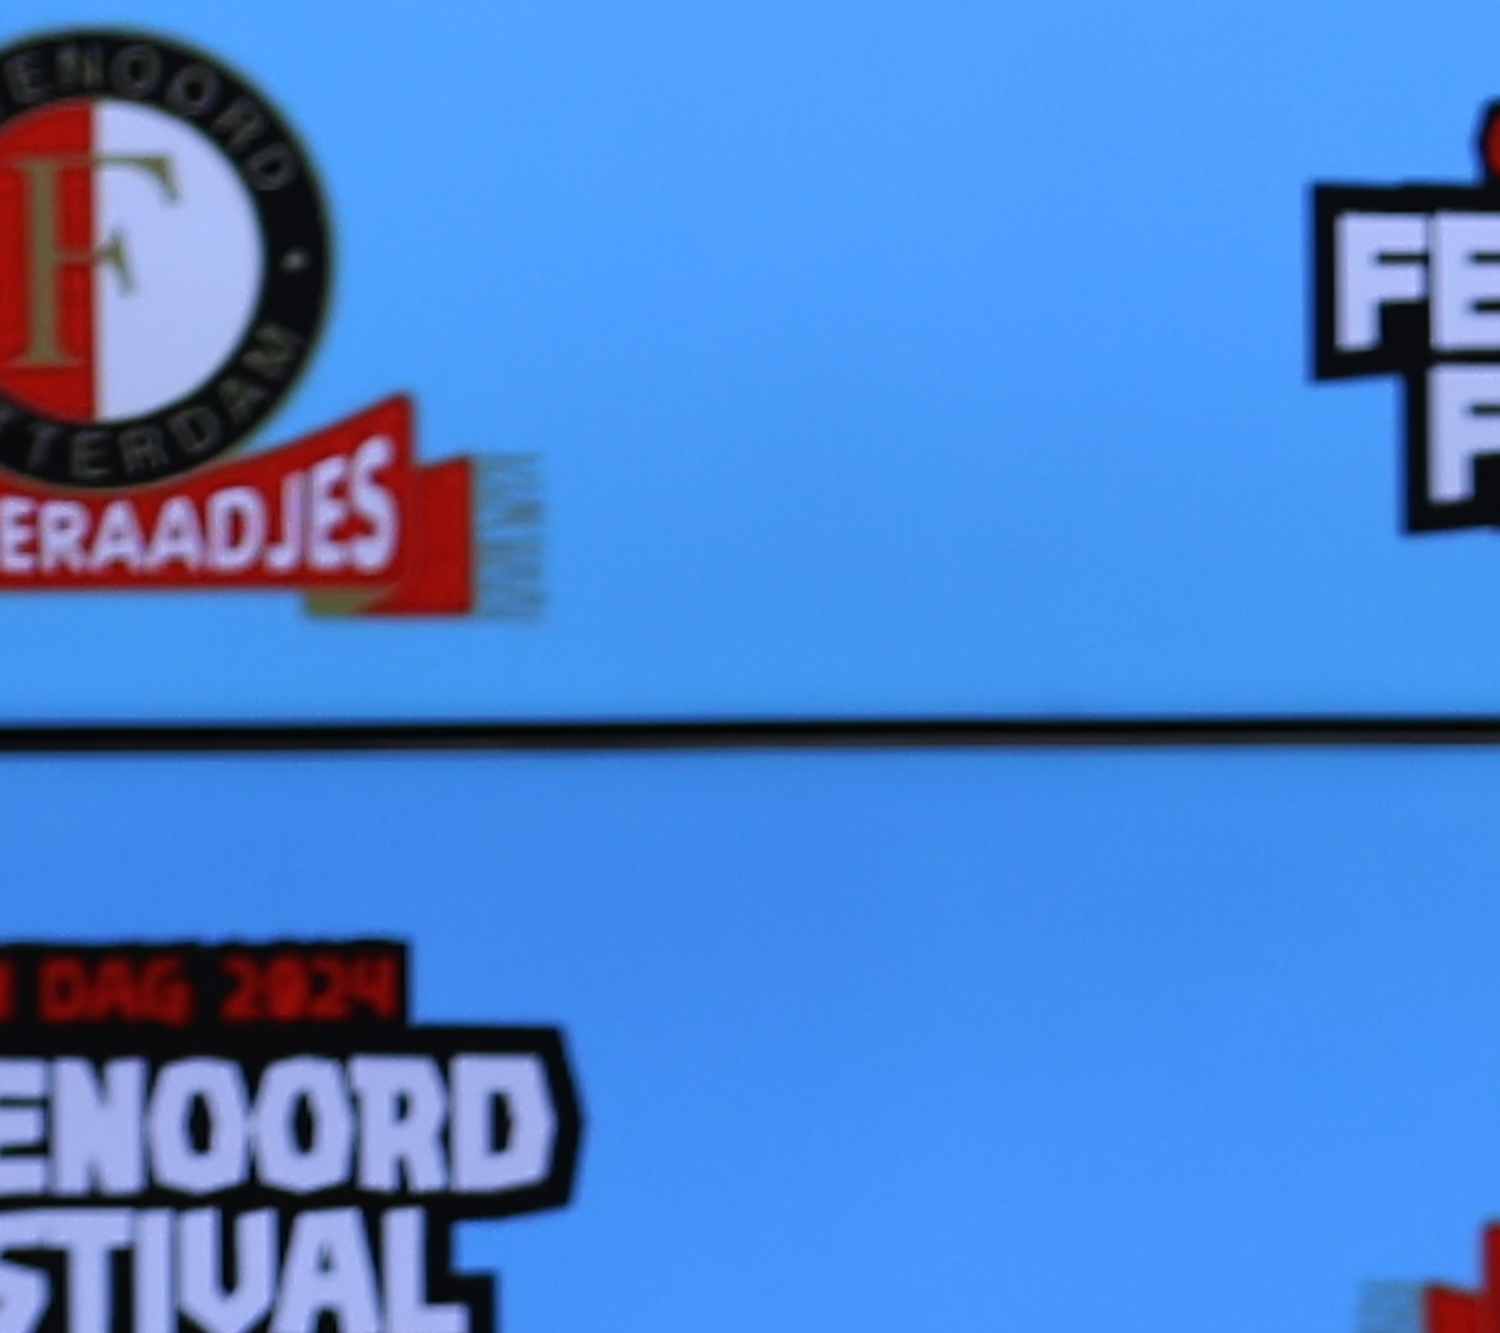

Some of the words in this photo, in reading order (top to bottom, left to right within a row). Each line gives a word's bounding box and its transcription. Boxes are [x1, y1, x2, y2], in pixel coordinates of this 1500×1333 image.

[0, 434, 398, 573] ERAADJES
[38, 955, 193, 1029] DAG
[219, 955, 398, 1021] 2024
